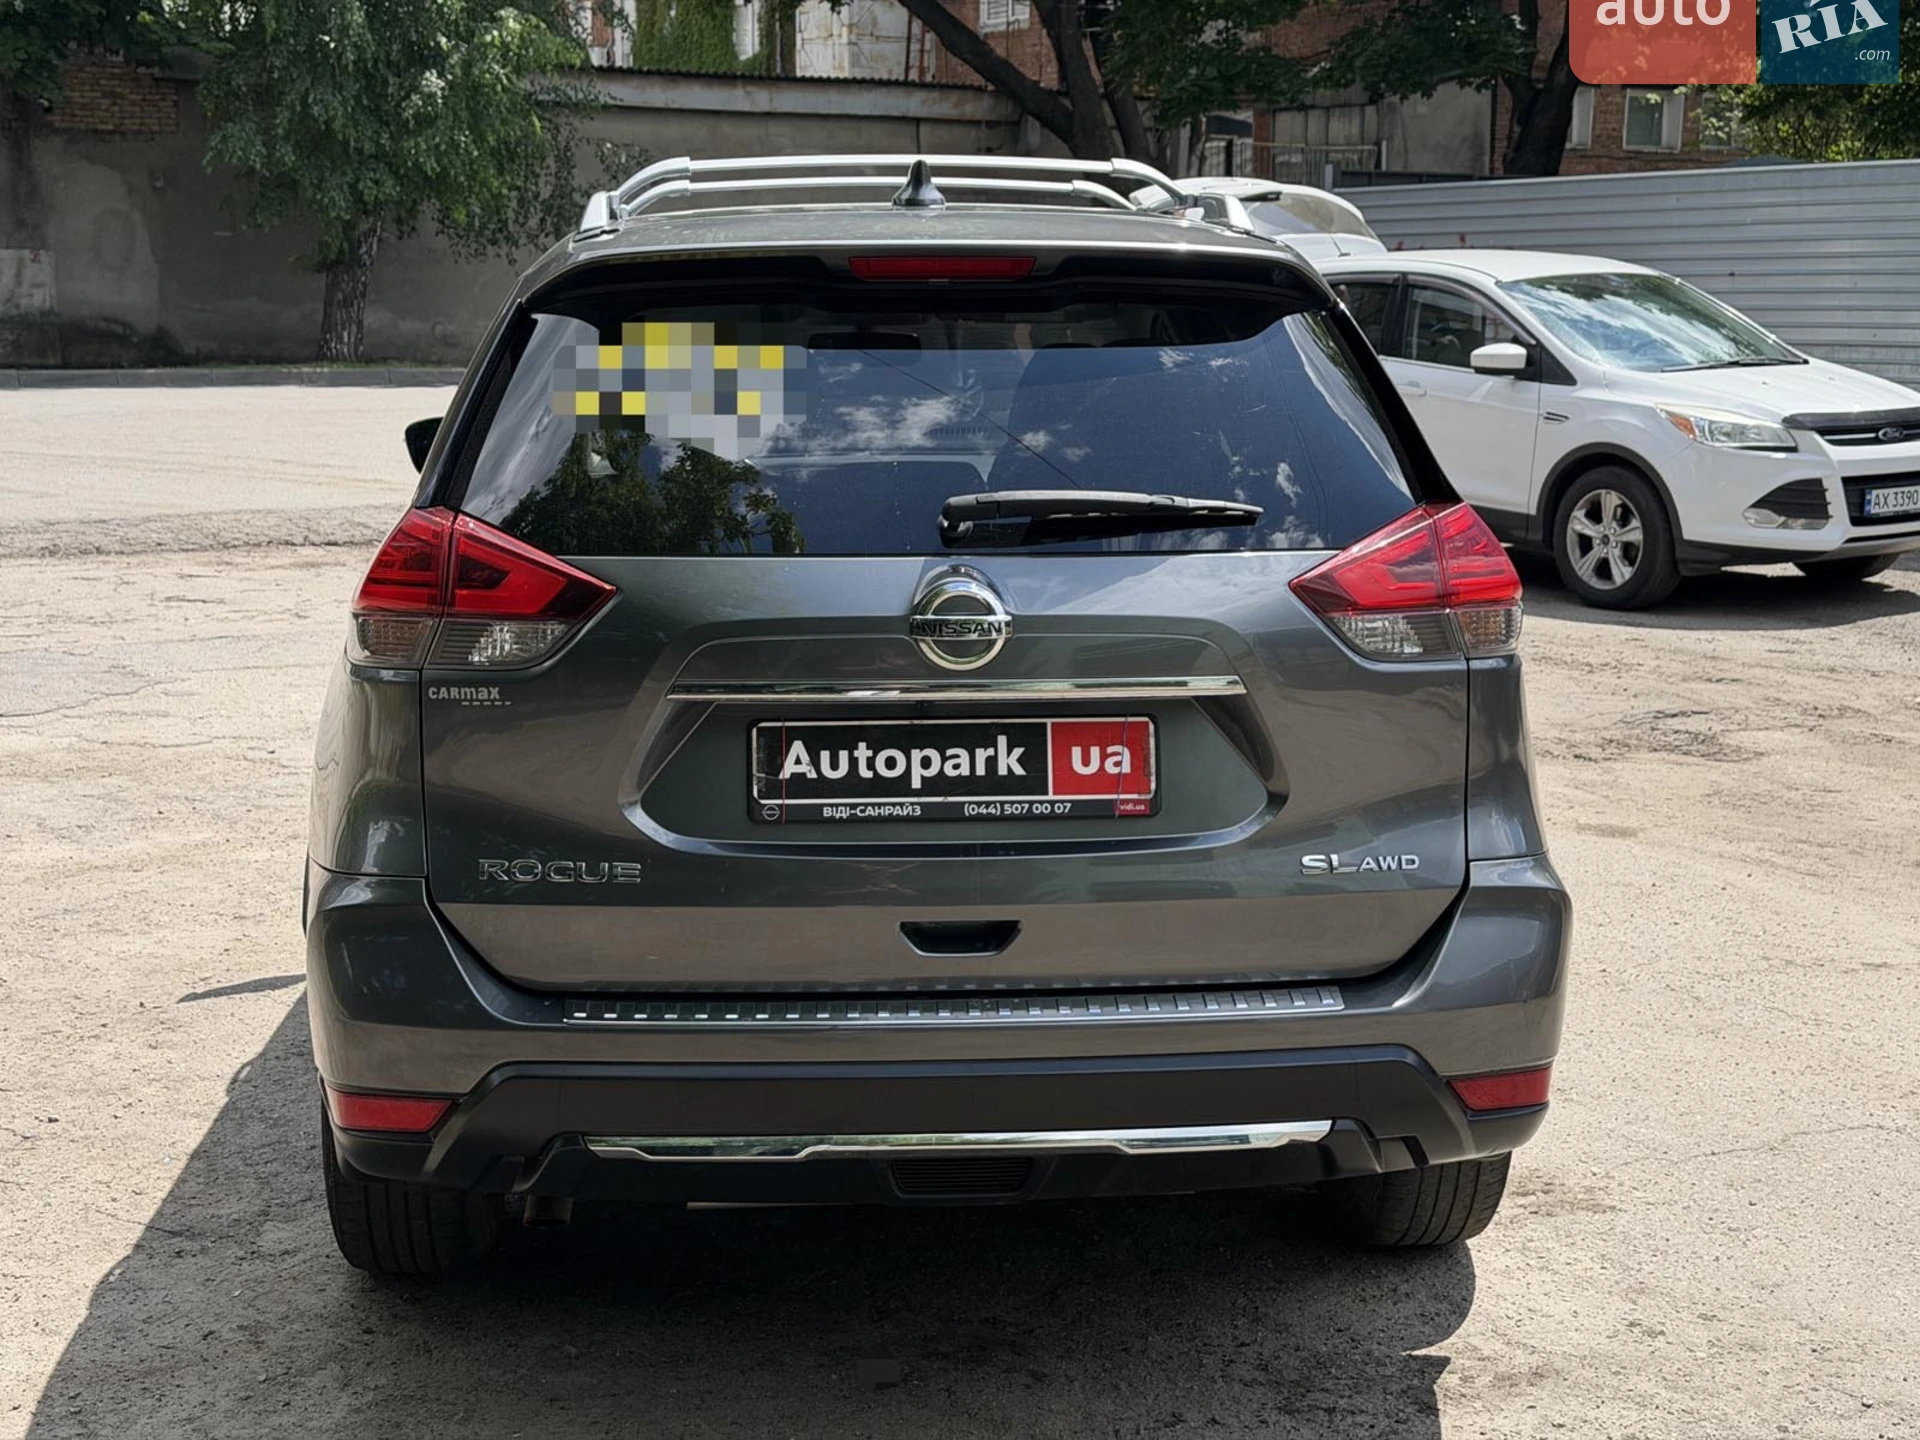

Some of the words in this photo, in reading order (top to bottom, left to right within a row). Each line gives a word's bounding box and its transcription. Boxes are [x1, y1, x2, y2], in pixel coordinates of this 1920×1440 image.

[1872, 492, 1890, 510] AX
[1891, 489, 1919, 508] 3390
[920, 621, 1002, 636] NISSAN
[778, 735, 1027, 789] Autopark
[1070, 744, 1132, 775] ua
[822, 803, 922, 819] ВІДІ-САНРАЙЗ
[963, 803, 1001, 816] (044)
[1003, 803, 1029, 815] 507
[1032, 803, 1051, 814] 00
[1054, 803, 1072, 814] 07
[478, 858, 642, 883] ROGUE
[1301, 853, 1358, 875] SL
[1359, 854, 1420, 872] AWD
